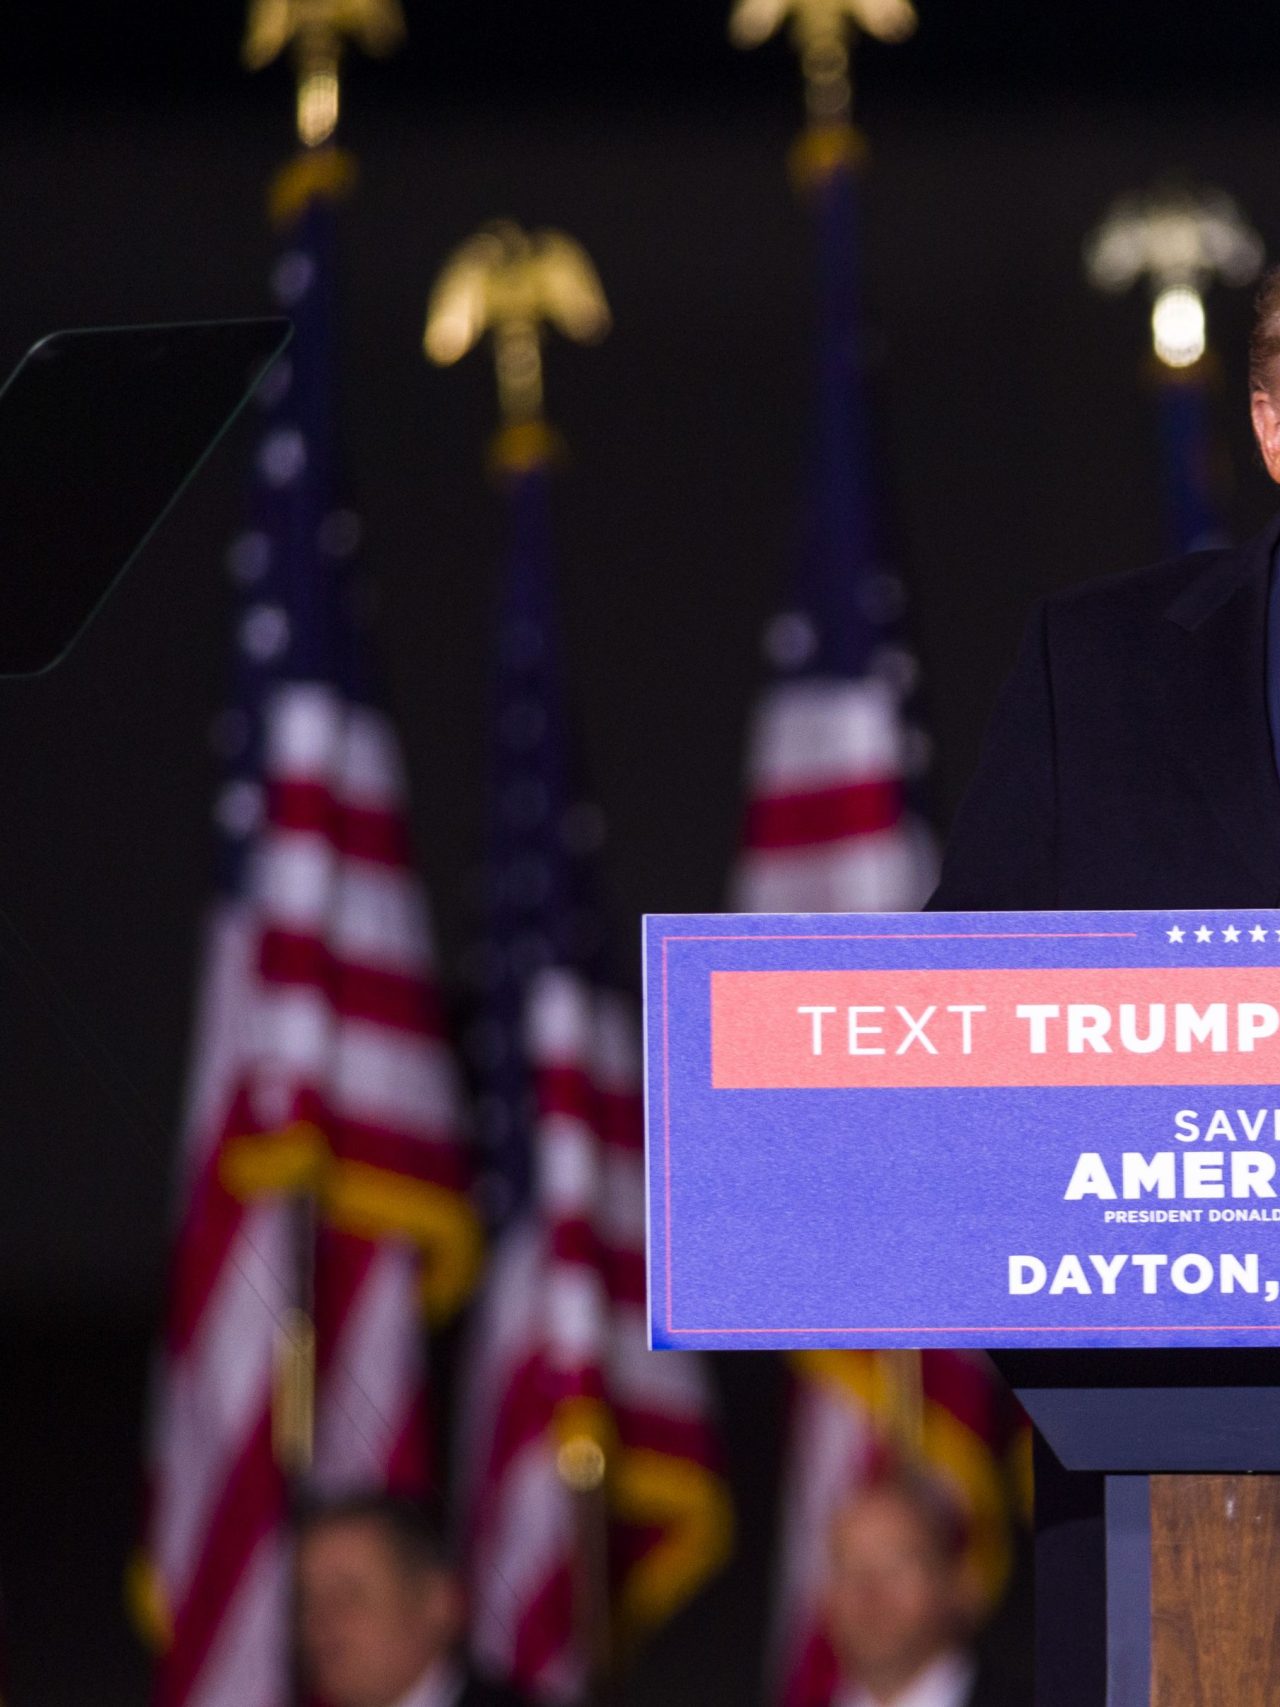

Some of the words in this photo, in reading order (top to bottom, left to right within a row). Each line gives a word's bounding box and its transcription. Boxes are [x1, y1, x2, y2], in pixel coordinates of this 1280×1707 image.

[798, 1005, 986, 1055] TEXT
[1016, 1003, 1279, 1053] TRUMP
[1105, 1210, 1203, 1222] PRESIDENT
[1009, 1254, 1279, 1301] DAYTON,
